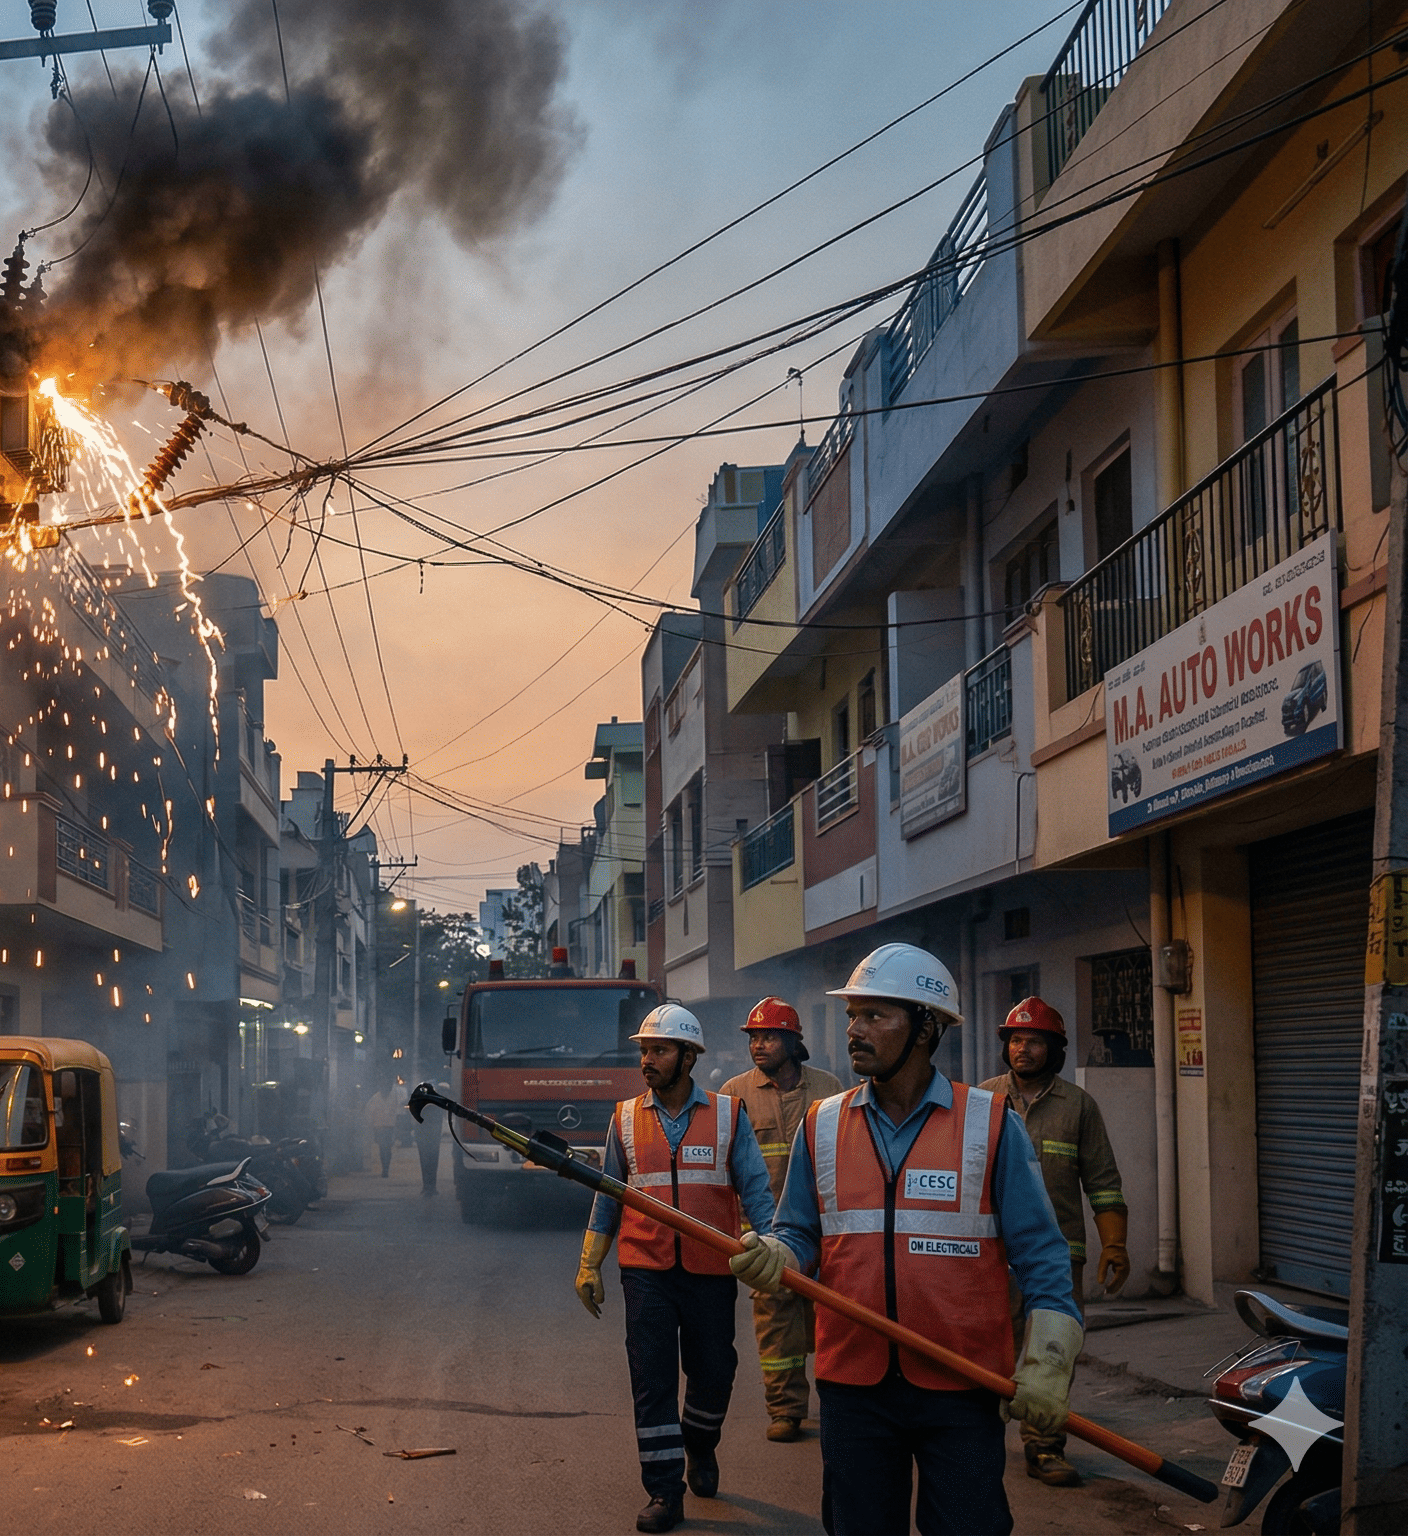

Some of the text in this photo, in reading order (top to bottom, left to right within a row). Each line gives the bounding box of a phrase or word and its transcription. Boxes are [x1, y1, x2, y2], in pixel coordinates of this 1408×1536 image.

[1113, 685, 1153, 746] M.A.
[1159, 645, 1217, 723] AUTO
[1224, 585, 1323, 687] WORKS
[916, 975, 950, 996] CESC
[919, 1175, 955, 1189] CESC
